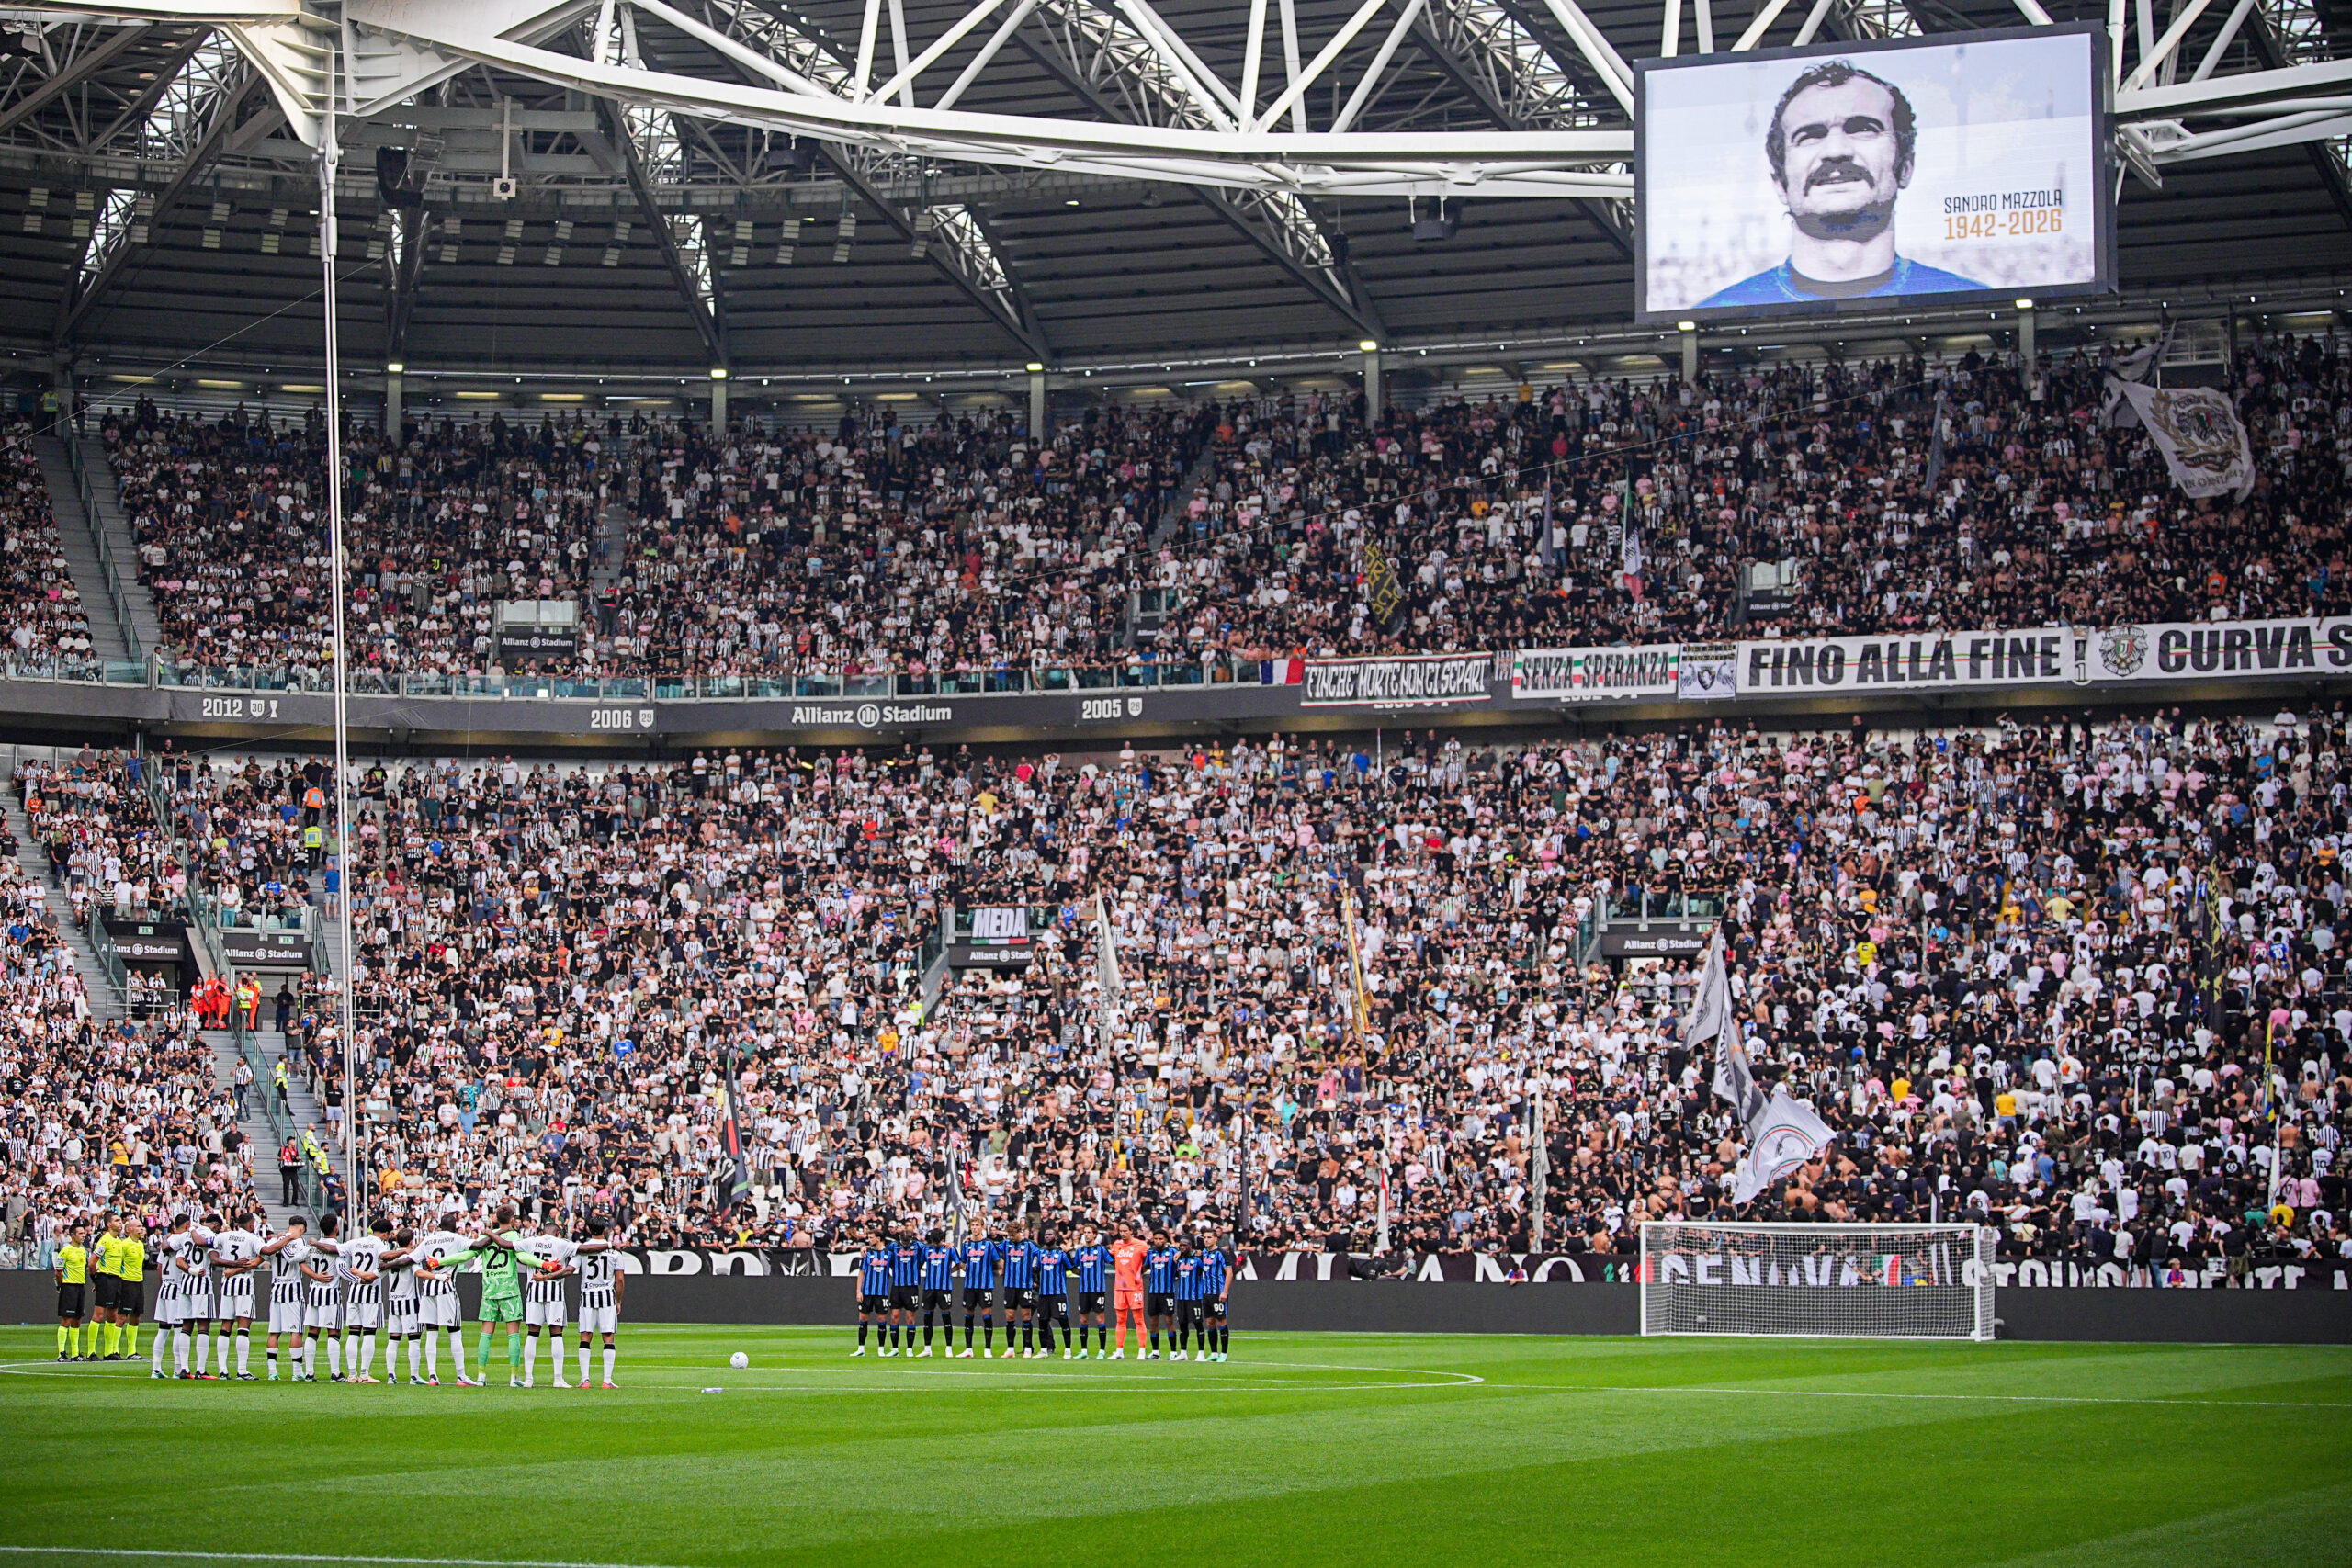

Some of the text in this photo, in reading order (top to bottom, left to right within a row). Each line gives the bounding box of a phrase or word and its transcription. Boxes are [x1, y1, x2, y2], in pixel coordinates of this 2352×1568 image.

[1944, 189, 2062, 214] SANDRO MAZZOLA
[1944, 209, 2062, 240] 1942-2026
[502, 637, 573, 647] Allianz Stadium
[2158, 626, 2316, 673] CURVA
[1521, 651, 1670, 691] SENZA SPERANZA
[1748, 636, 2062, 687] FINO ALLA FINE
[1357, 662, 1399, 698] MORTE
[1397, 661, 1424, 696] NON
[202, 698, 243, 717] 2012
[792, 705, 952, 724] Allianz Stadium
[1081, 698, 1122, 719] 2005
[591, 709, 632, 728] 2006
[971, 907, 1027, 938] MEDA
[101, 944, 178, 955] Aianz Stadium
[223, 948, 303, 959] Allianz Stadium
[1624, 940, 1657, 950] Allianz
[969, 951, 998, 961] Allianz
[184, 1241, 204, 1265] 26
[355, 1252, 374, 1273] 22
[586, 1255, 608, 1280] 31
[910, 1295, 919, 1304] 17
[1023, 1291, 1033, 1300] 42
[1096, 1296, 1104, 1305] 47
[1057, 1303, 1067, 1312] 19
[1193, 1307, 1201, 1316] 11
[1213, 1303, 1225, 1312] 90
